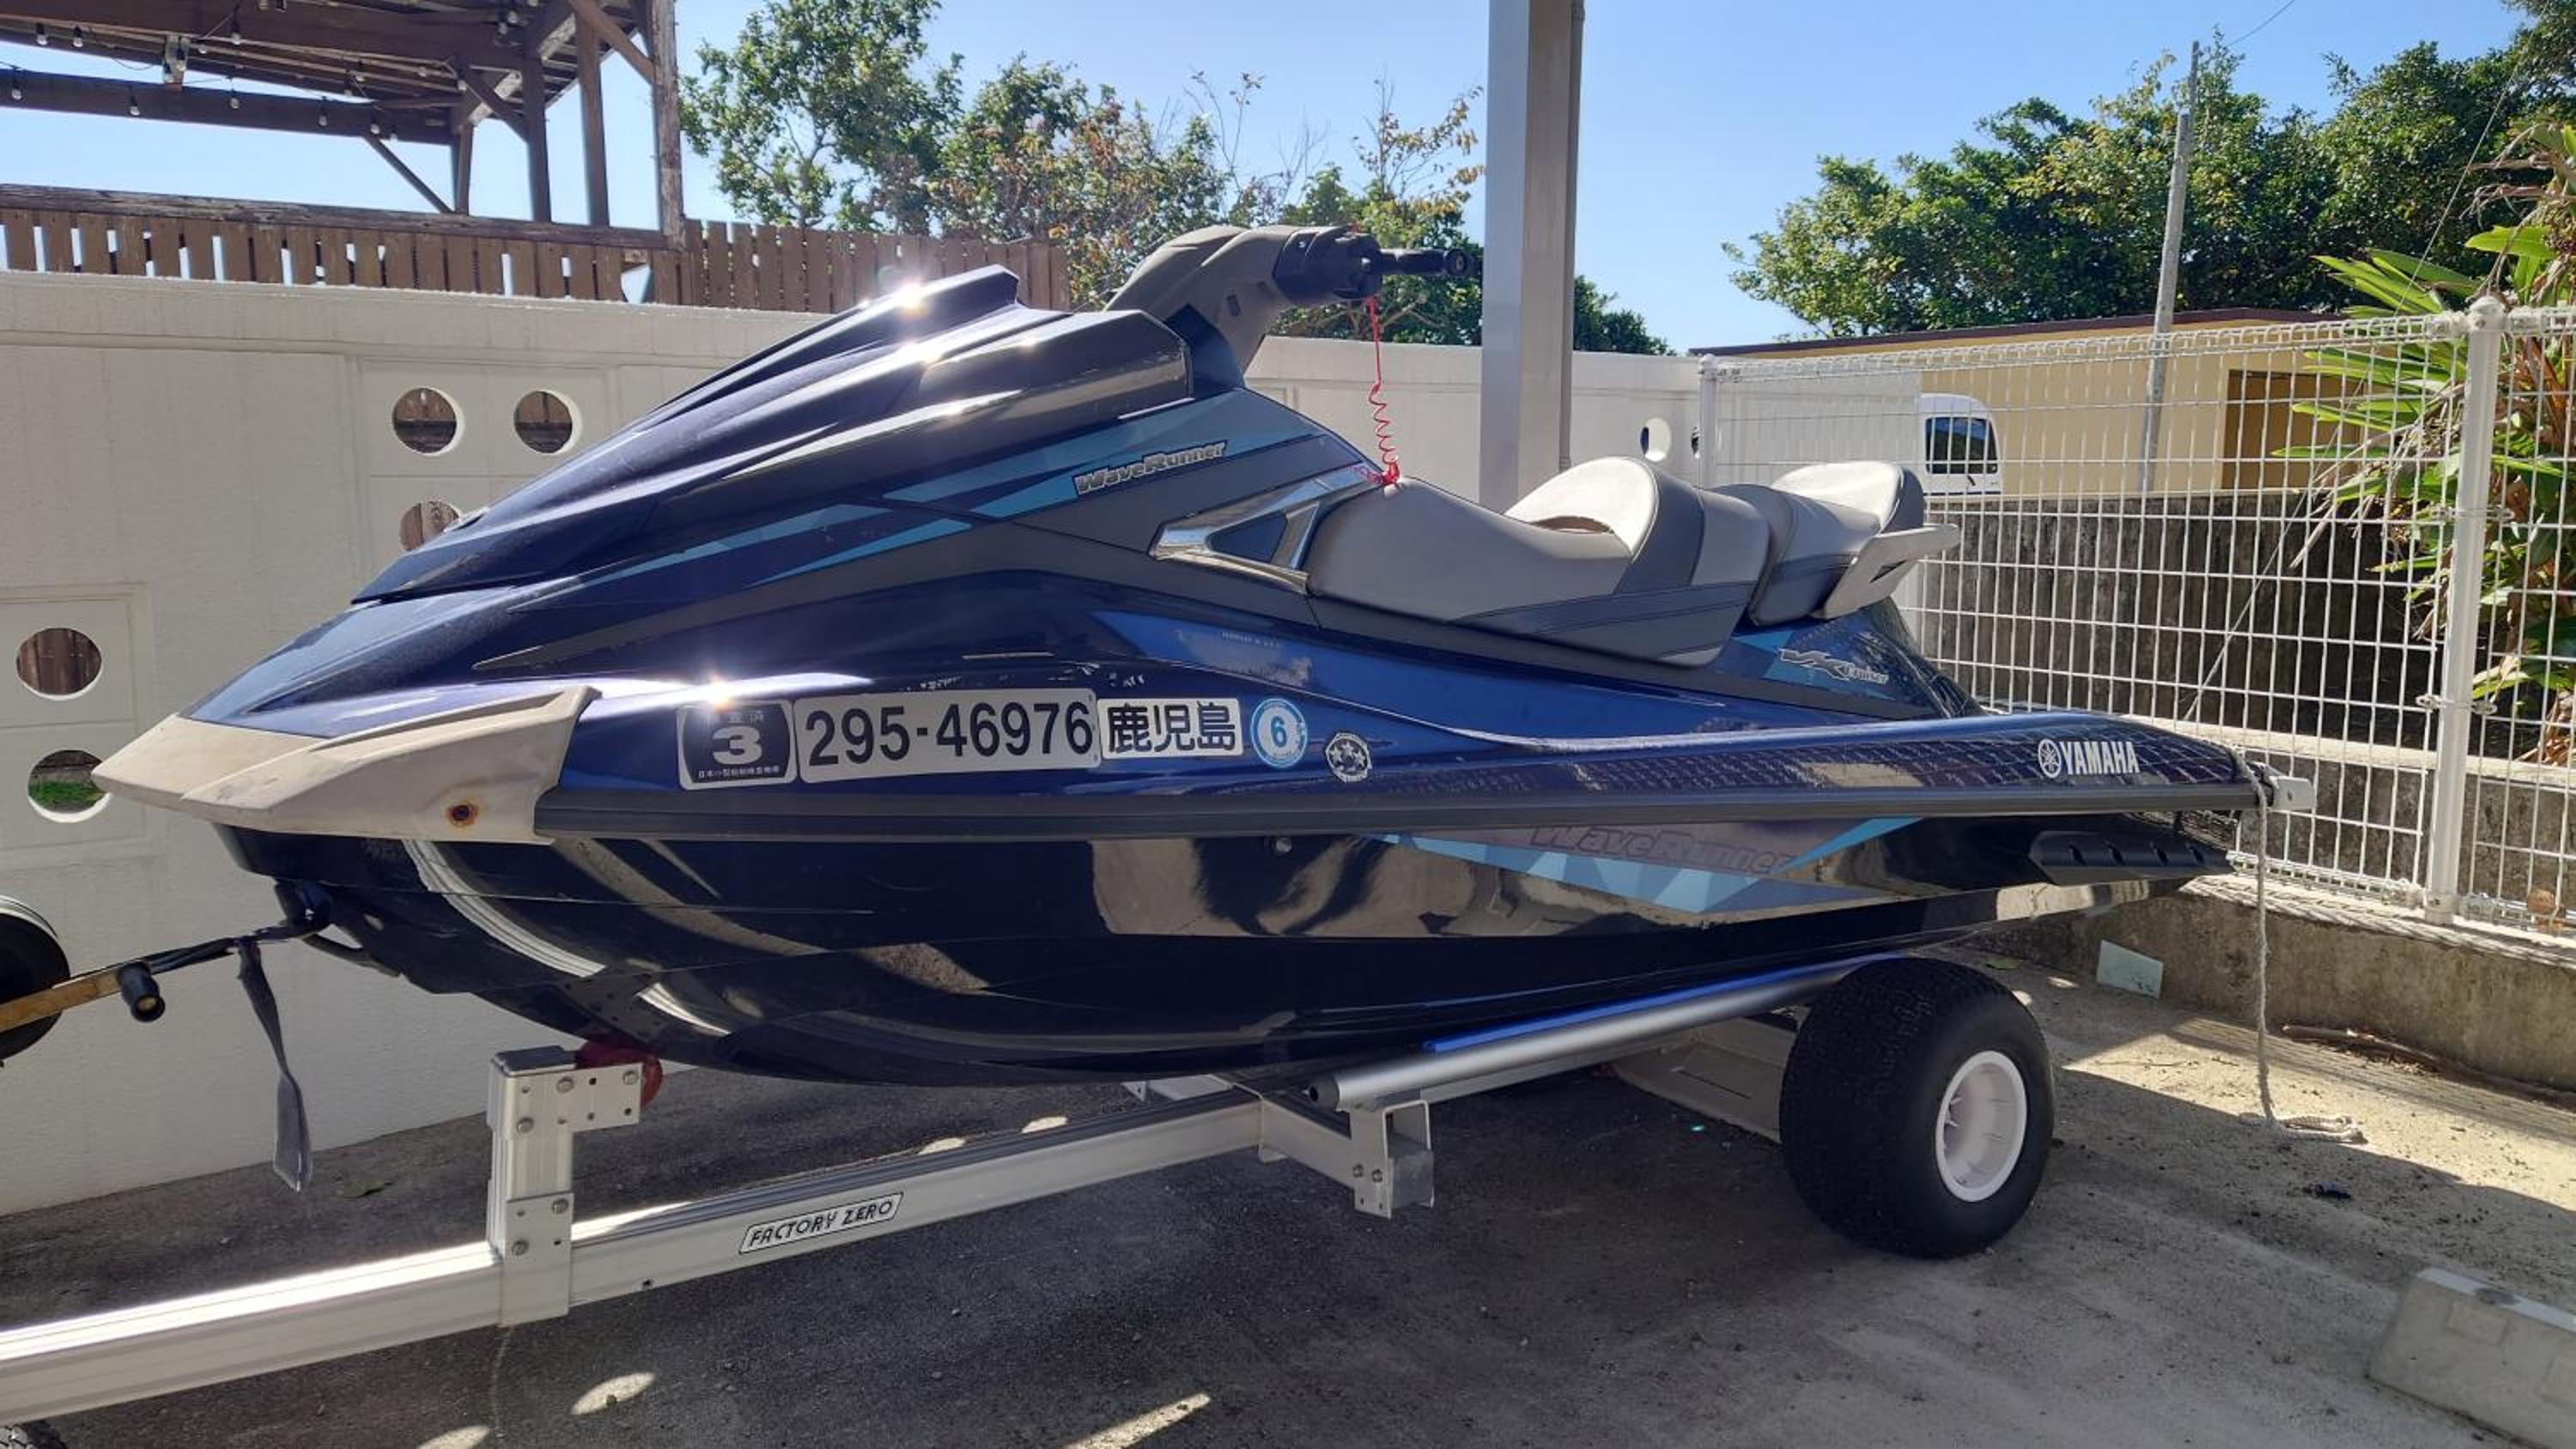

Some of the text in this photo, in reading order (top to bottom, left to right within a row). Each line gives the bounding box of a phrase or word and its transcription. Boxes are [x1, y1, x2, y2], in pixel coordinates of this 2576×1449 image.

[1074, 441, 1226, 495] WaveRunner
[713, 725, 762, 765] 3
[805, 701, 1093, 767] 295-46976
[1107, 700, 1236, 754] 鹿児島
[1271, 716, 1287, 748] 6
[2059, 741, 2141, 774] YAMAHA
[750, 1200, 893, 1247] FACTORY ZERO
